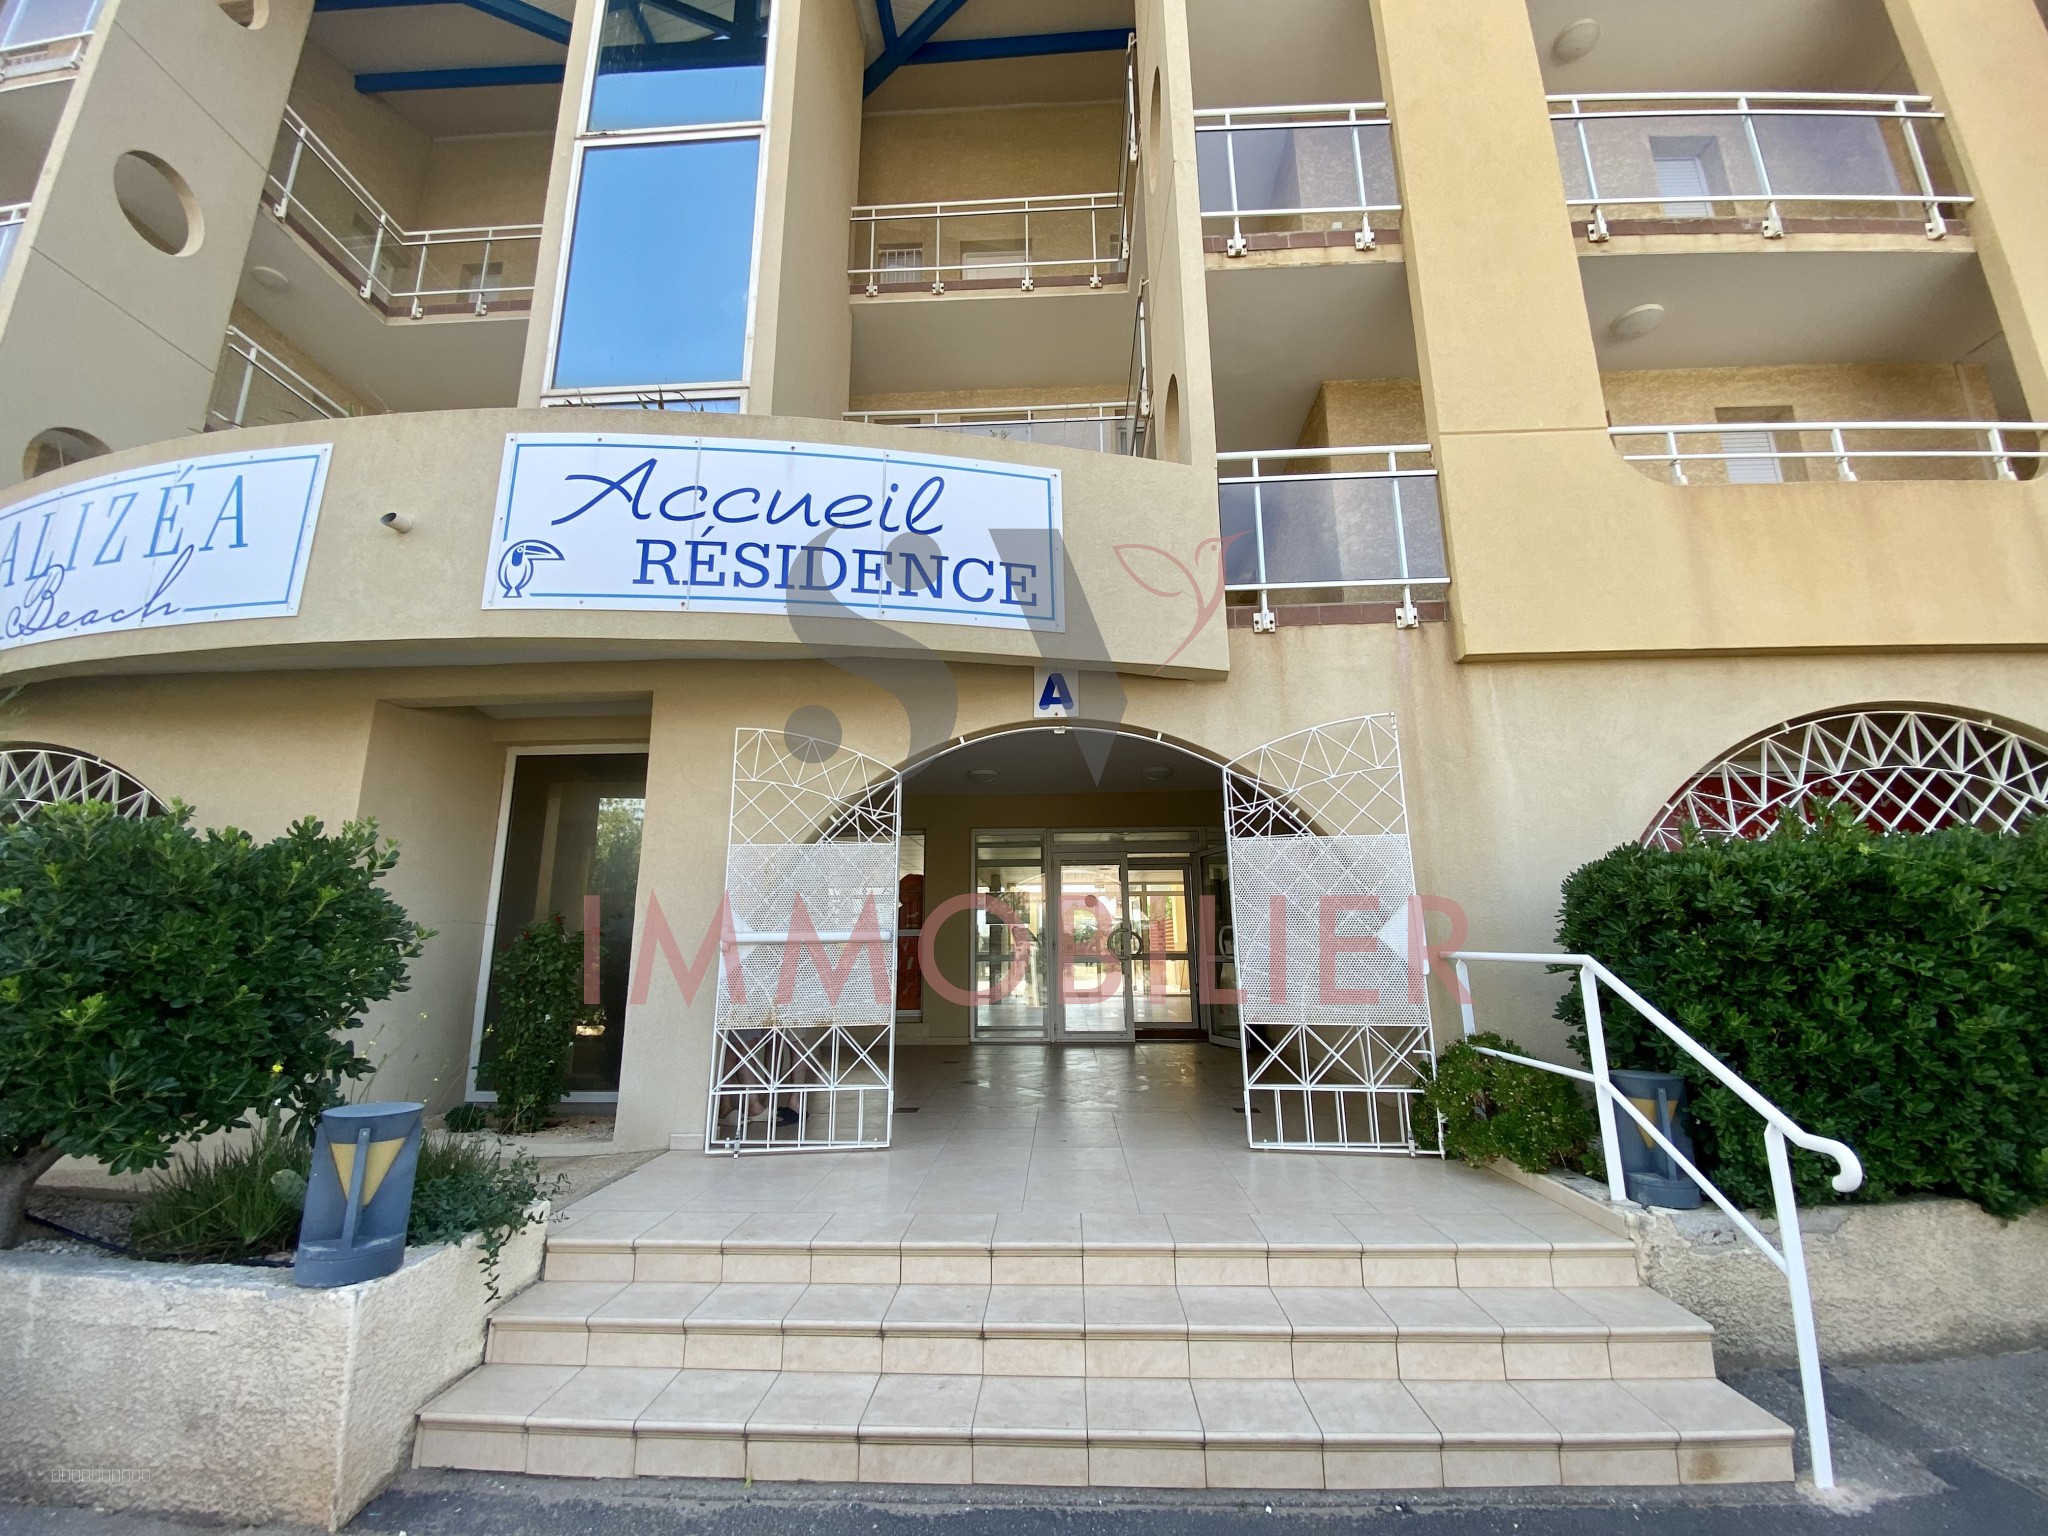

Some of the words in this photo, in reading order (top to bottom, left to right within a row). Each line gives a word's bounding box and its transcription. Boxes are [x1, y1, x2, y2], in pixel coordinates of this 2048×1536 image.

[551, 457, 945, 535] Accueil
[631, 524, 1037, 607] RÉSIDENCE
[1038, 672, 1075, 711] A
